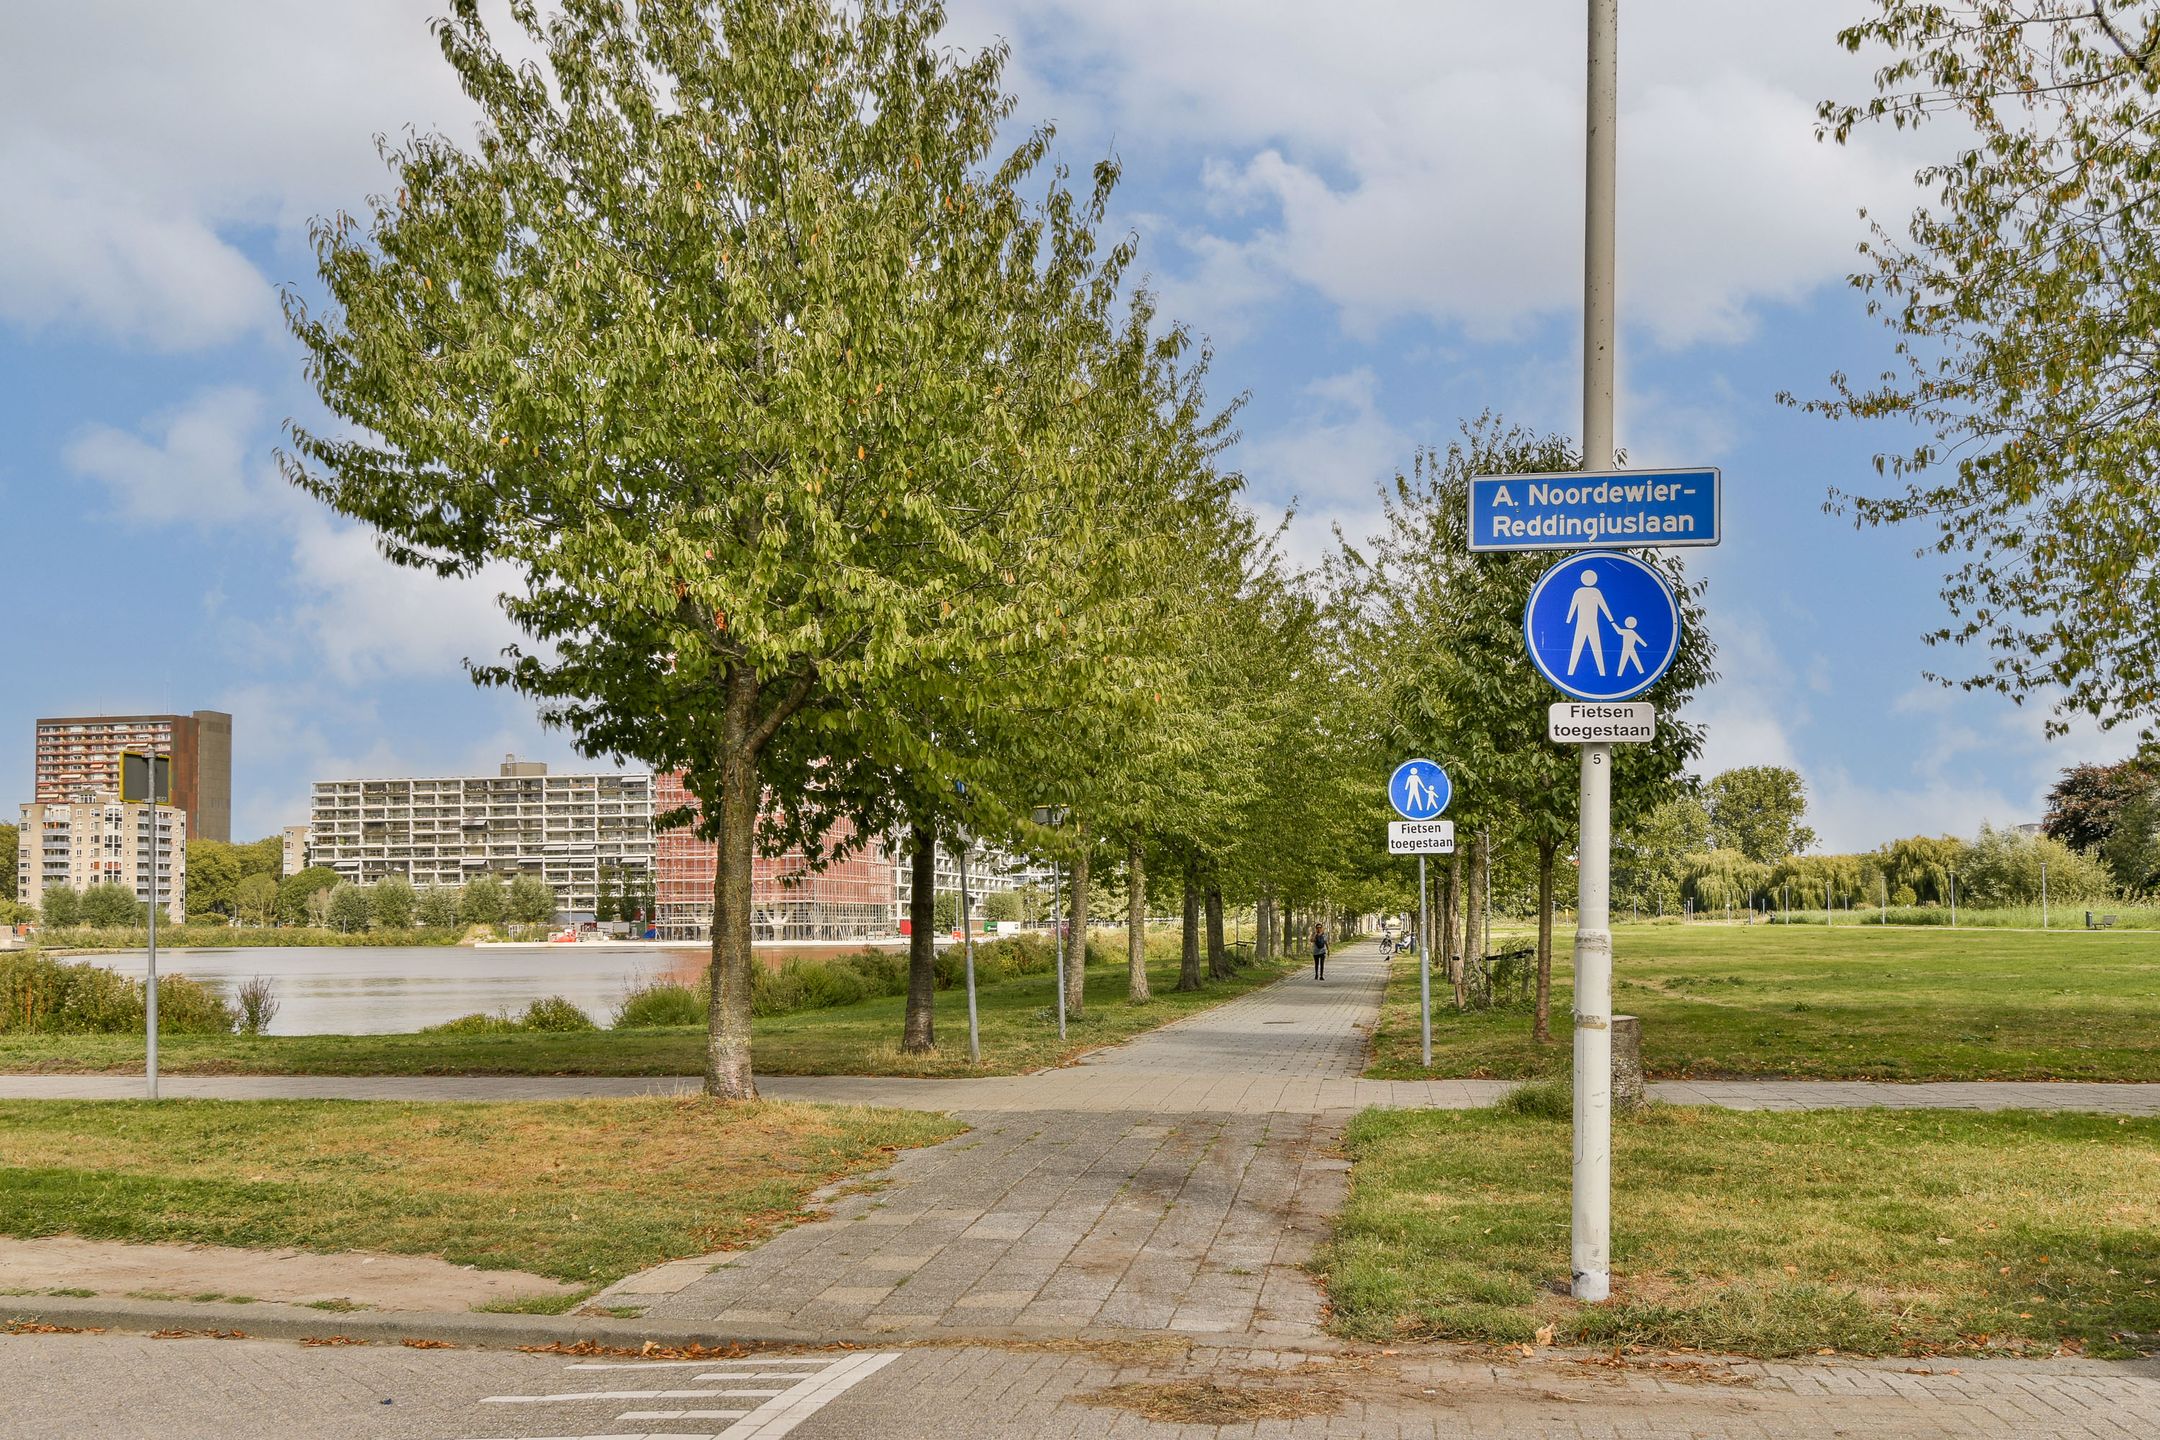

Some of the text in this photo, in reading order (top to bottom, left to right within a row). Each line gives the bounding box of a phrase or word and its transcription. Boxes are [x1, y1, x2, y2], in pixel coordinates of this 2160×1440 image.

[1492, 480, 1696, 507] A. Noordewier-
[1492, 511, 1695, 542] Reddingiuslaan
[1570, 705, 1633, 717] Fietsen
[1554, 724, 1650, 739] toegestaan
[1593, 754, 1601, 765] 5
[1401, 823, 1441, 834] Fietsen
[1391, 839, 1452, 851] toegestaan
